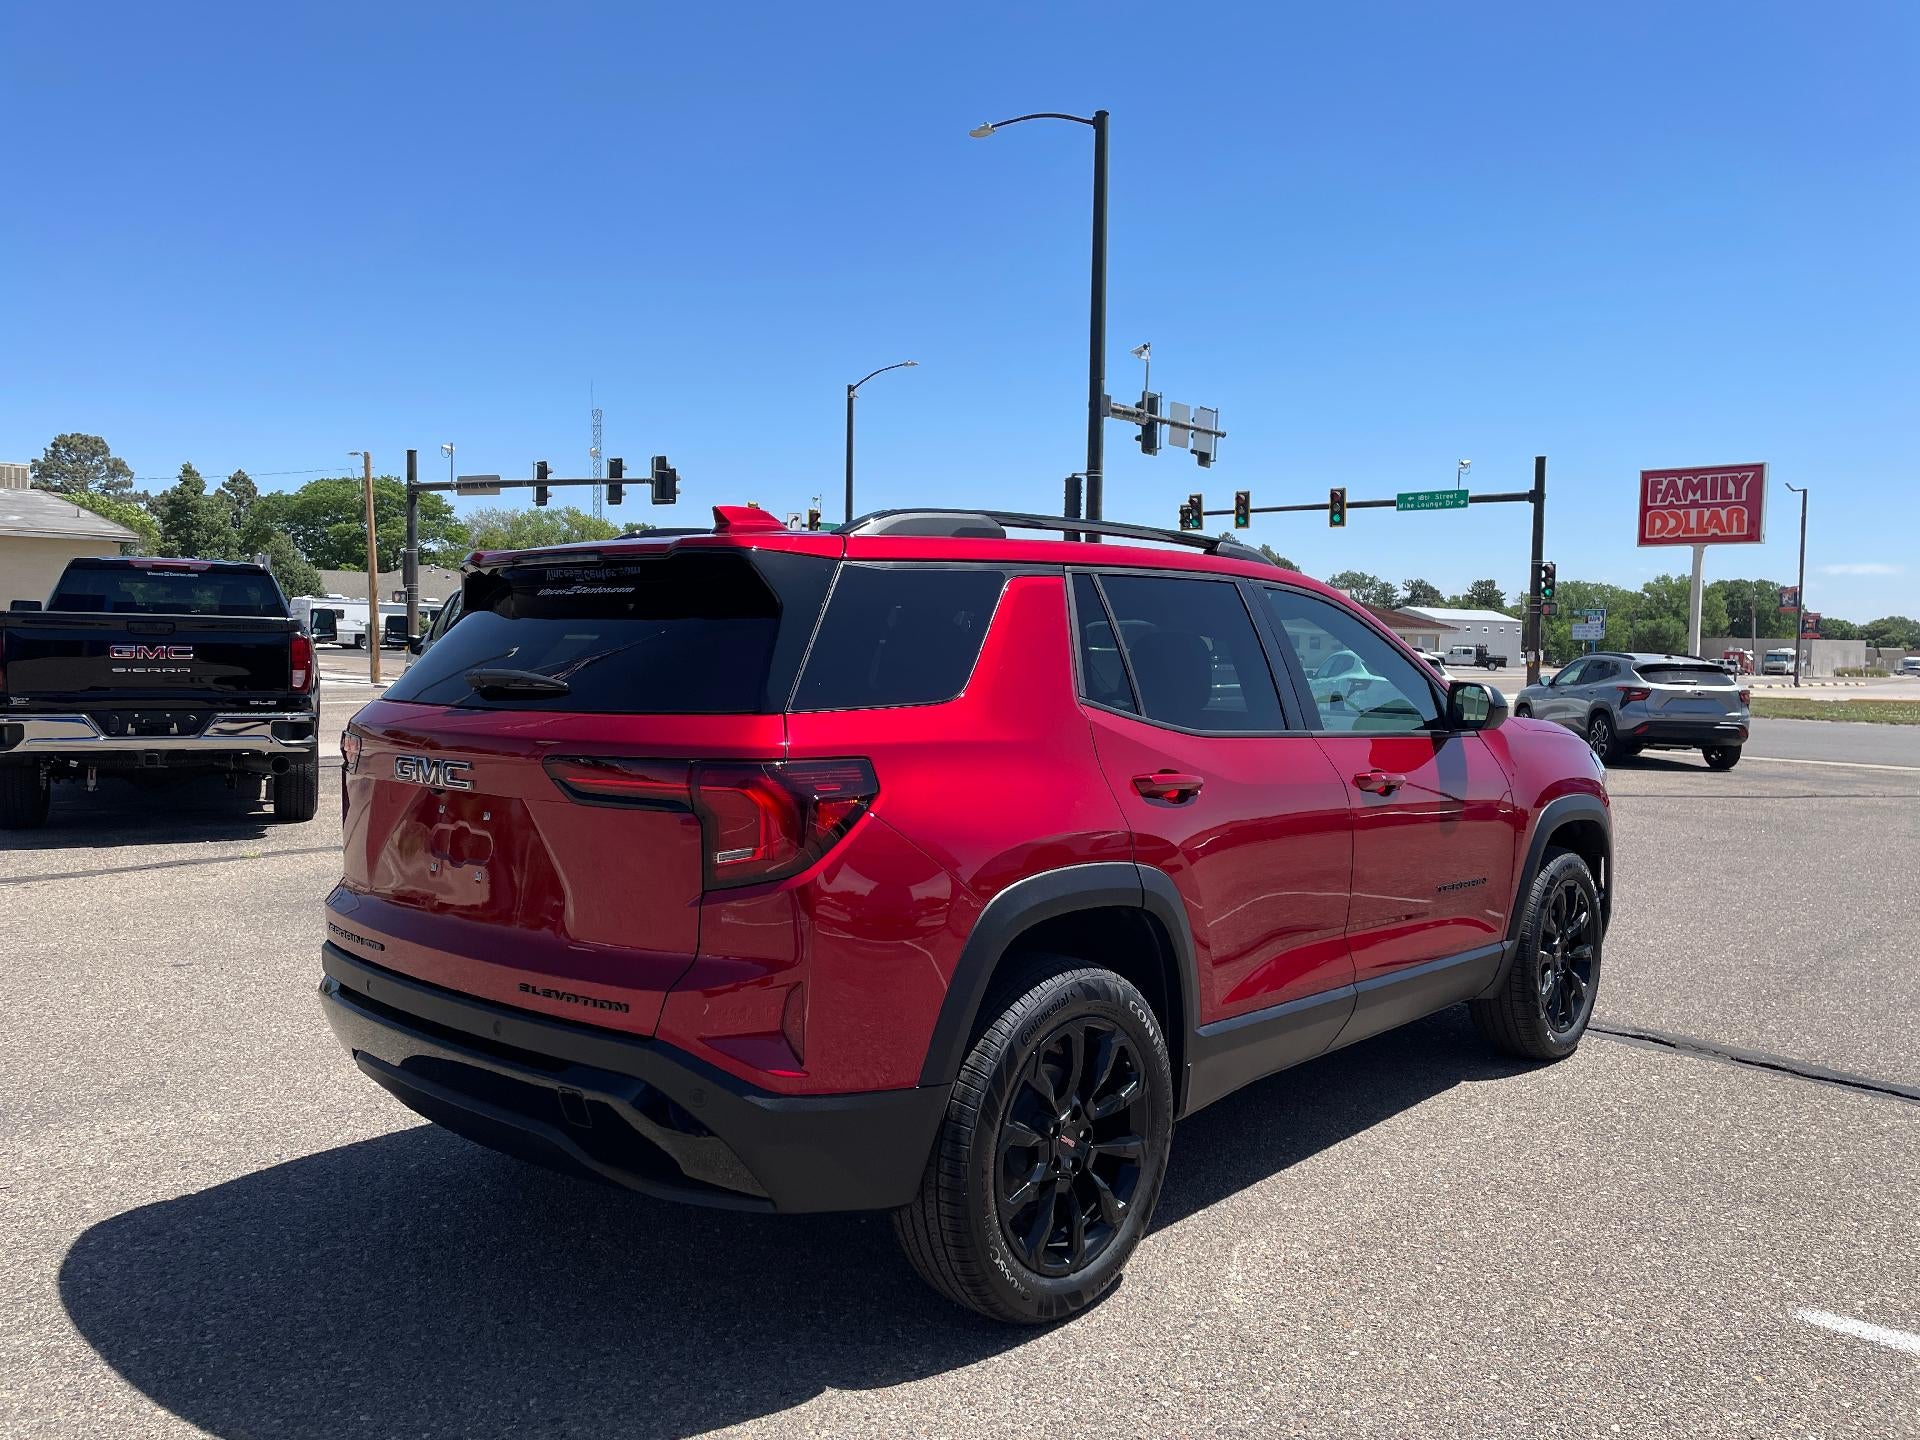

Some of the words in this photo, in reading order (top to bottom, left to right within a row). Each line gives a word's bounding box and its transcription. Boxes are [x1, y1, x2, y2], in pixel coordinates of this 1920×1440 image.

[1416, 500, 1443, 508] Lounge
[1434, 492, 1458, 500] Street
[1647, 471, 1755, 506] FAMILY
[1645, 505, 1748, 539] DOLLAR
[109, 645, 193, 660] GMC
[394, 754, 475, 791] GMC
[517, 982, 630, 1013] ELEVATION
